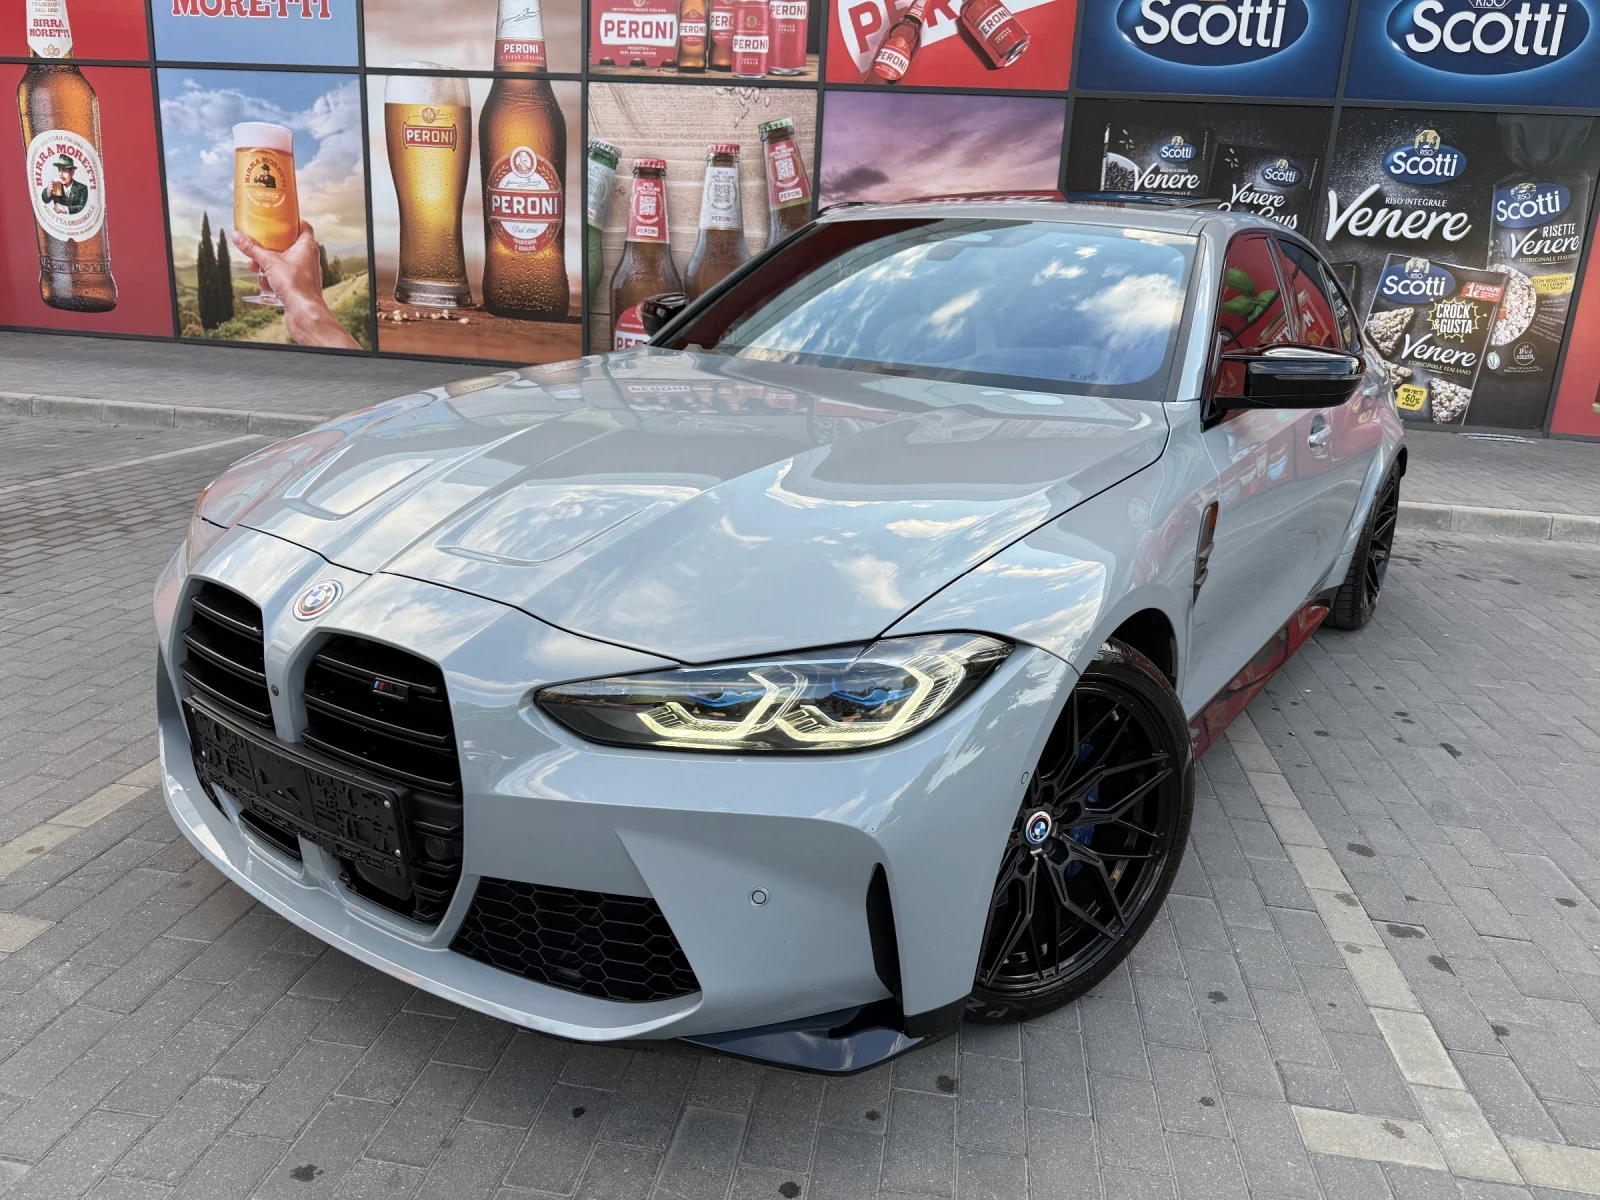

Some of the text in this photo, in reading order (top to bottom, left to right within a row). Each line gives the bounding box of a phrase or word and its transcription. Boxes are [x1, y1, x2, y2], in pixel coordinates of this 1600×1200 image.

[771, 5, 806, 15] PERONI
[33, 19, 64, 27] BIRRA
[604, 20, 674, 39] PERONI
[680, 25, 706, 34] PERONI
[1135, 0, 1286, 47] Scotti
[1405, 0, 1567, 56] Scotti
[29, 29, 70, 37] MORETTI
[504, 44, 538, 53] PERONI
[734, 39, 767, 49] PERONI
[878, 51, 907, 72] PERONI
[406, 129, 453, 143] PERONI
[1160, 148, 1192, 159] Scotti
[35, 143, 97, 190] BIRRA MORETTI
[245, 157, 287, 188] BIRRA MORETTI
[1389, 151, 1458, 176] Scotti
[1133, 162, 1200, 191] Venere
[1264, 168, 1296, 183] Scotti
[1230, 182, 1286, 208] Venere
[1405, 198, 1447, 207] INTEGRALE
[491, 195, 558, 215] PERONI
[1326, 184, 1472, 241] Venere
[1496, 190, 1560, 222] Scotti
[1542, 223, 1576, 238] RISETTE
[1510, 228, 1580, 259] Venere
[1383, 275, 1446, 296] Scotti
[1436, 303, 1471, 319] CROCK
[1433, 319, 1473, 334] &GUSTA
[1401, 333, 1477, 367] Venere
[1408, 360, 1472, 375] L'ORIGINALE ITALIANO
